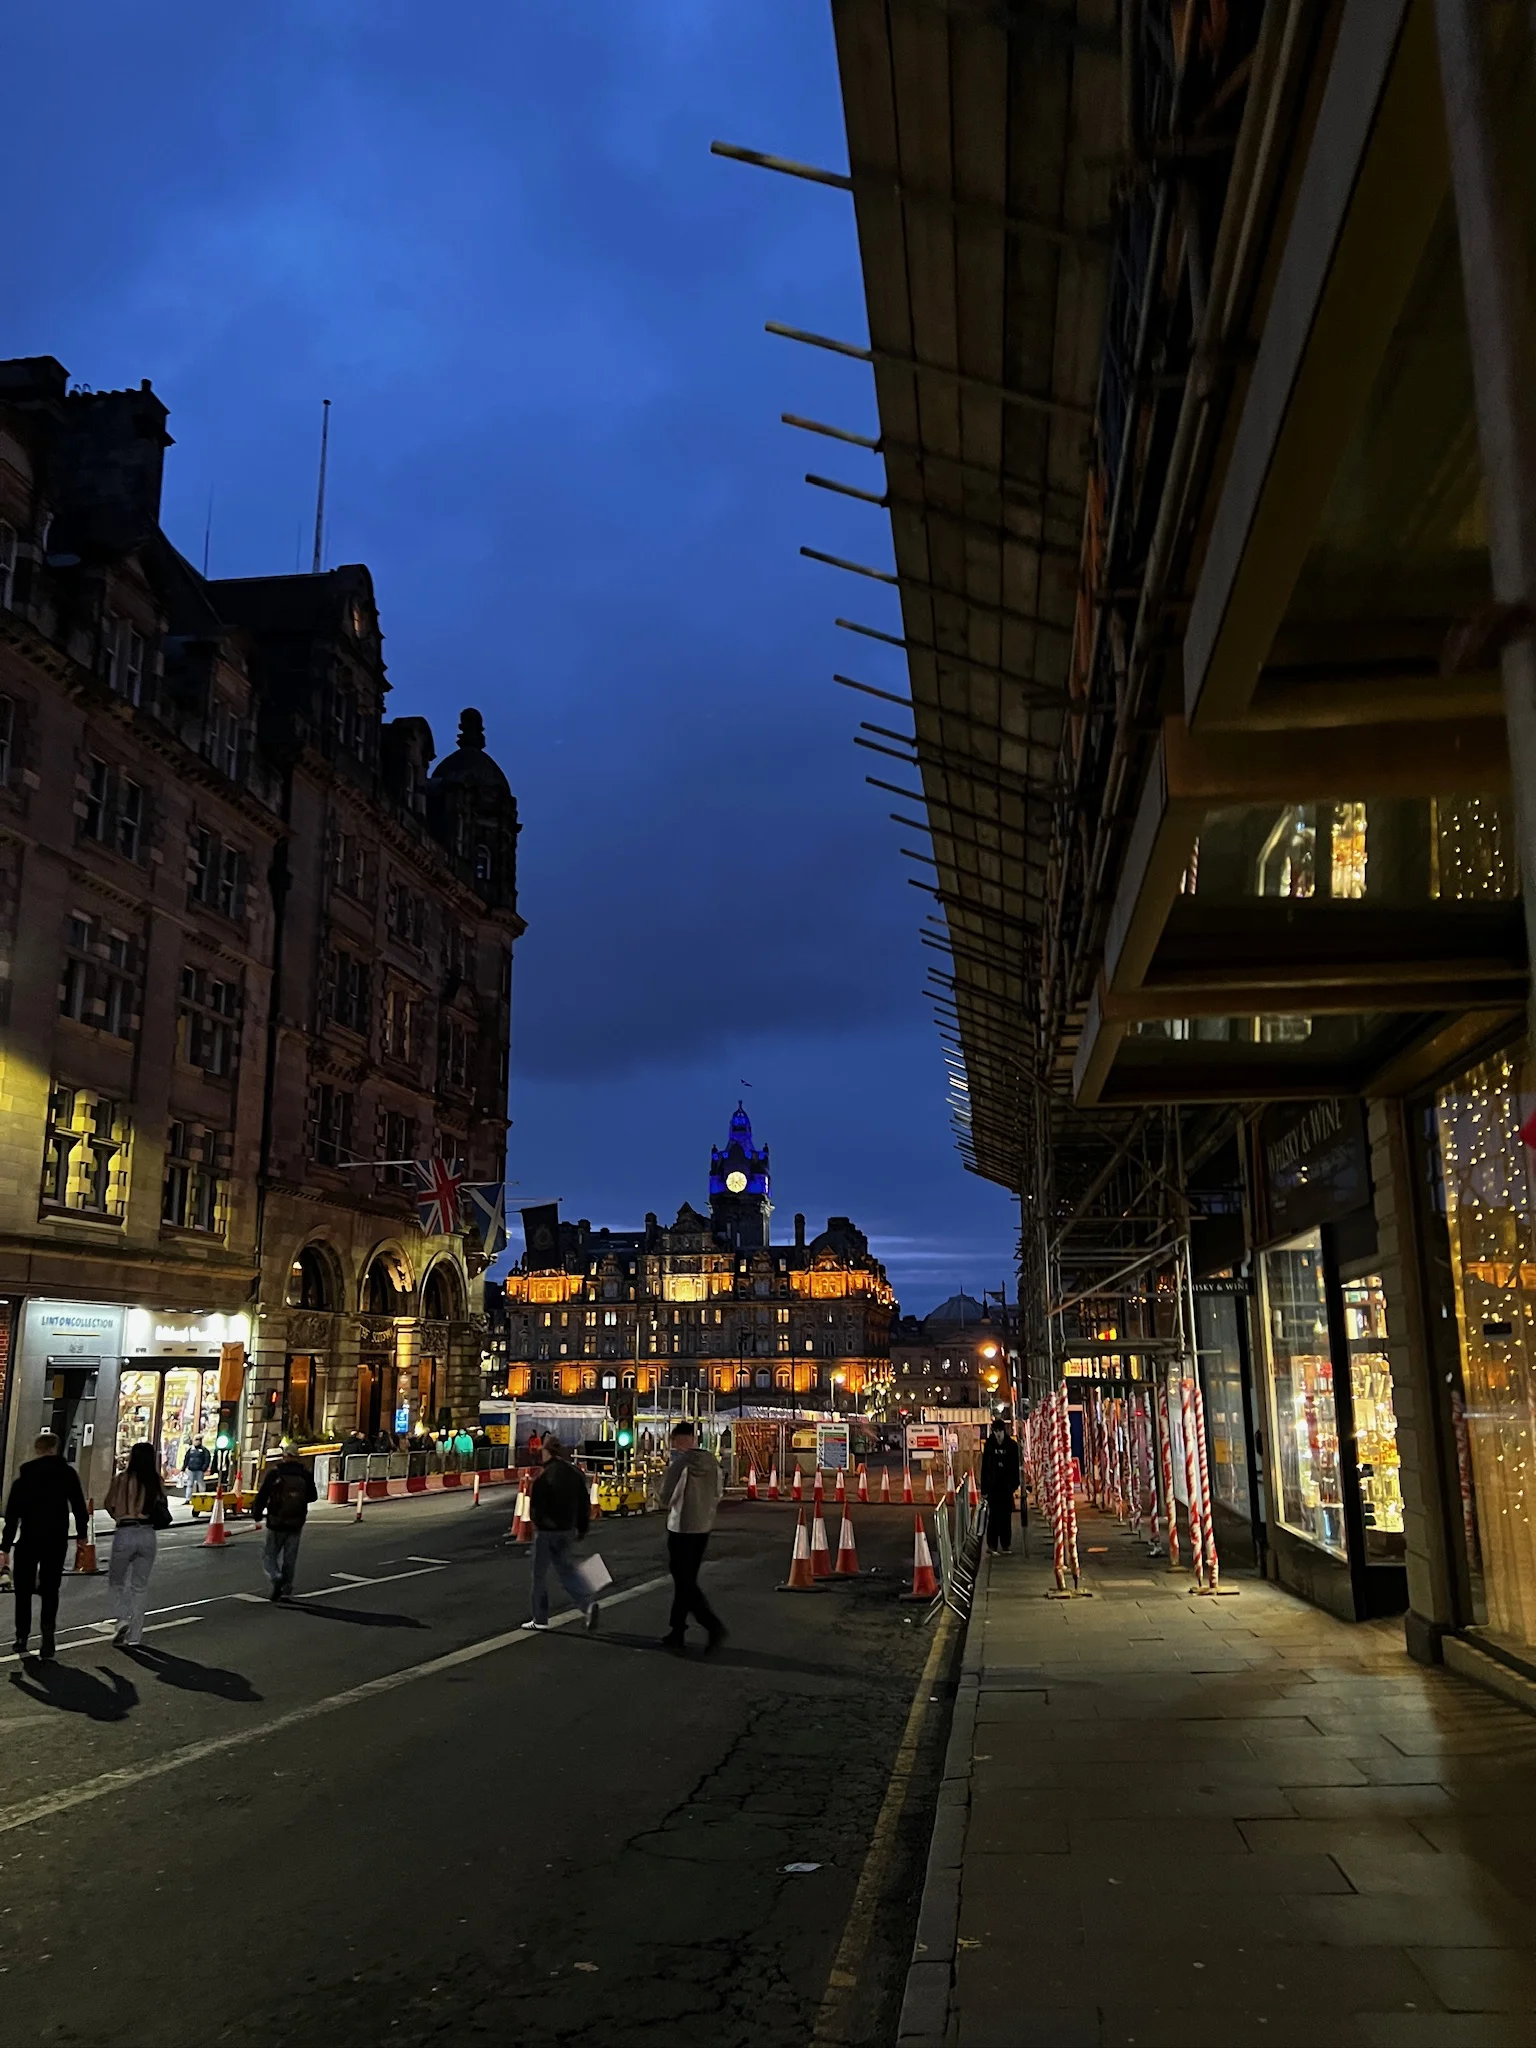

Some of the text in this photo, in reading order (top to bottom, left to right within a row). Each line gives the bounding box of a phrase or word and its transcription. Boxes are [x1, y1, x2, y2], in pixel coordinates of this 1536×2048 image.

[1266, 1097, 1344, 1176] WHISKY & WINE
